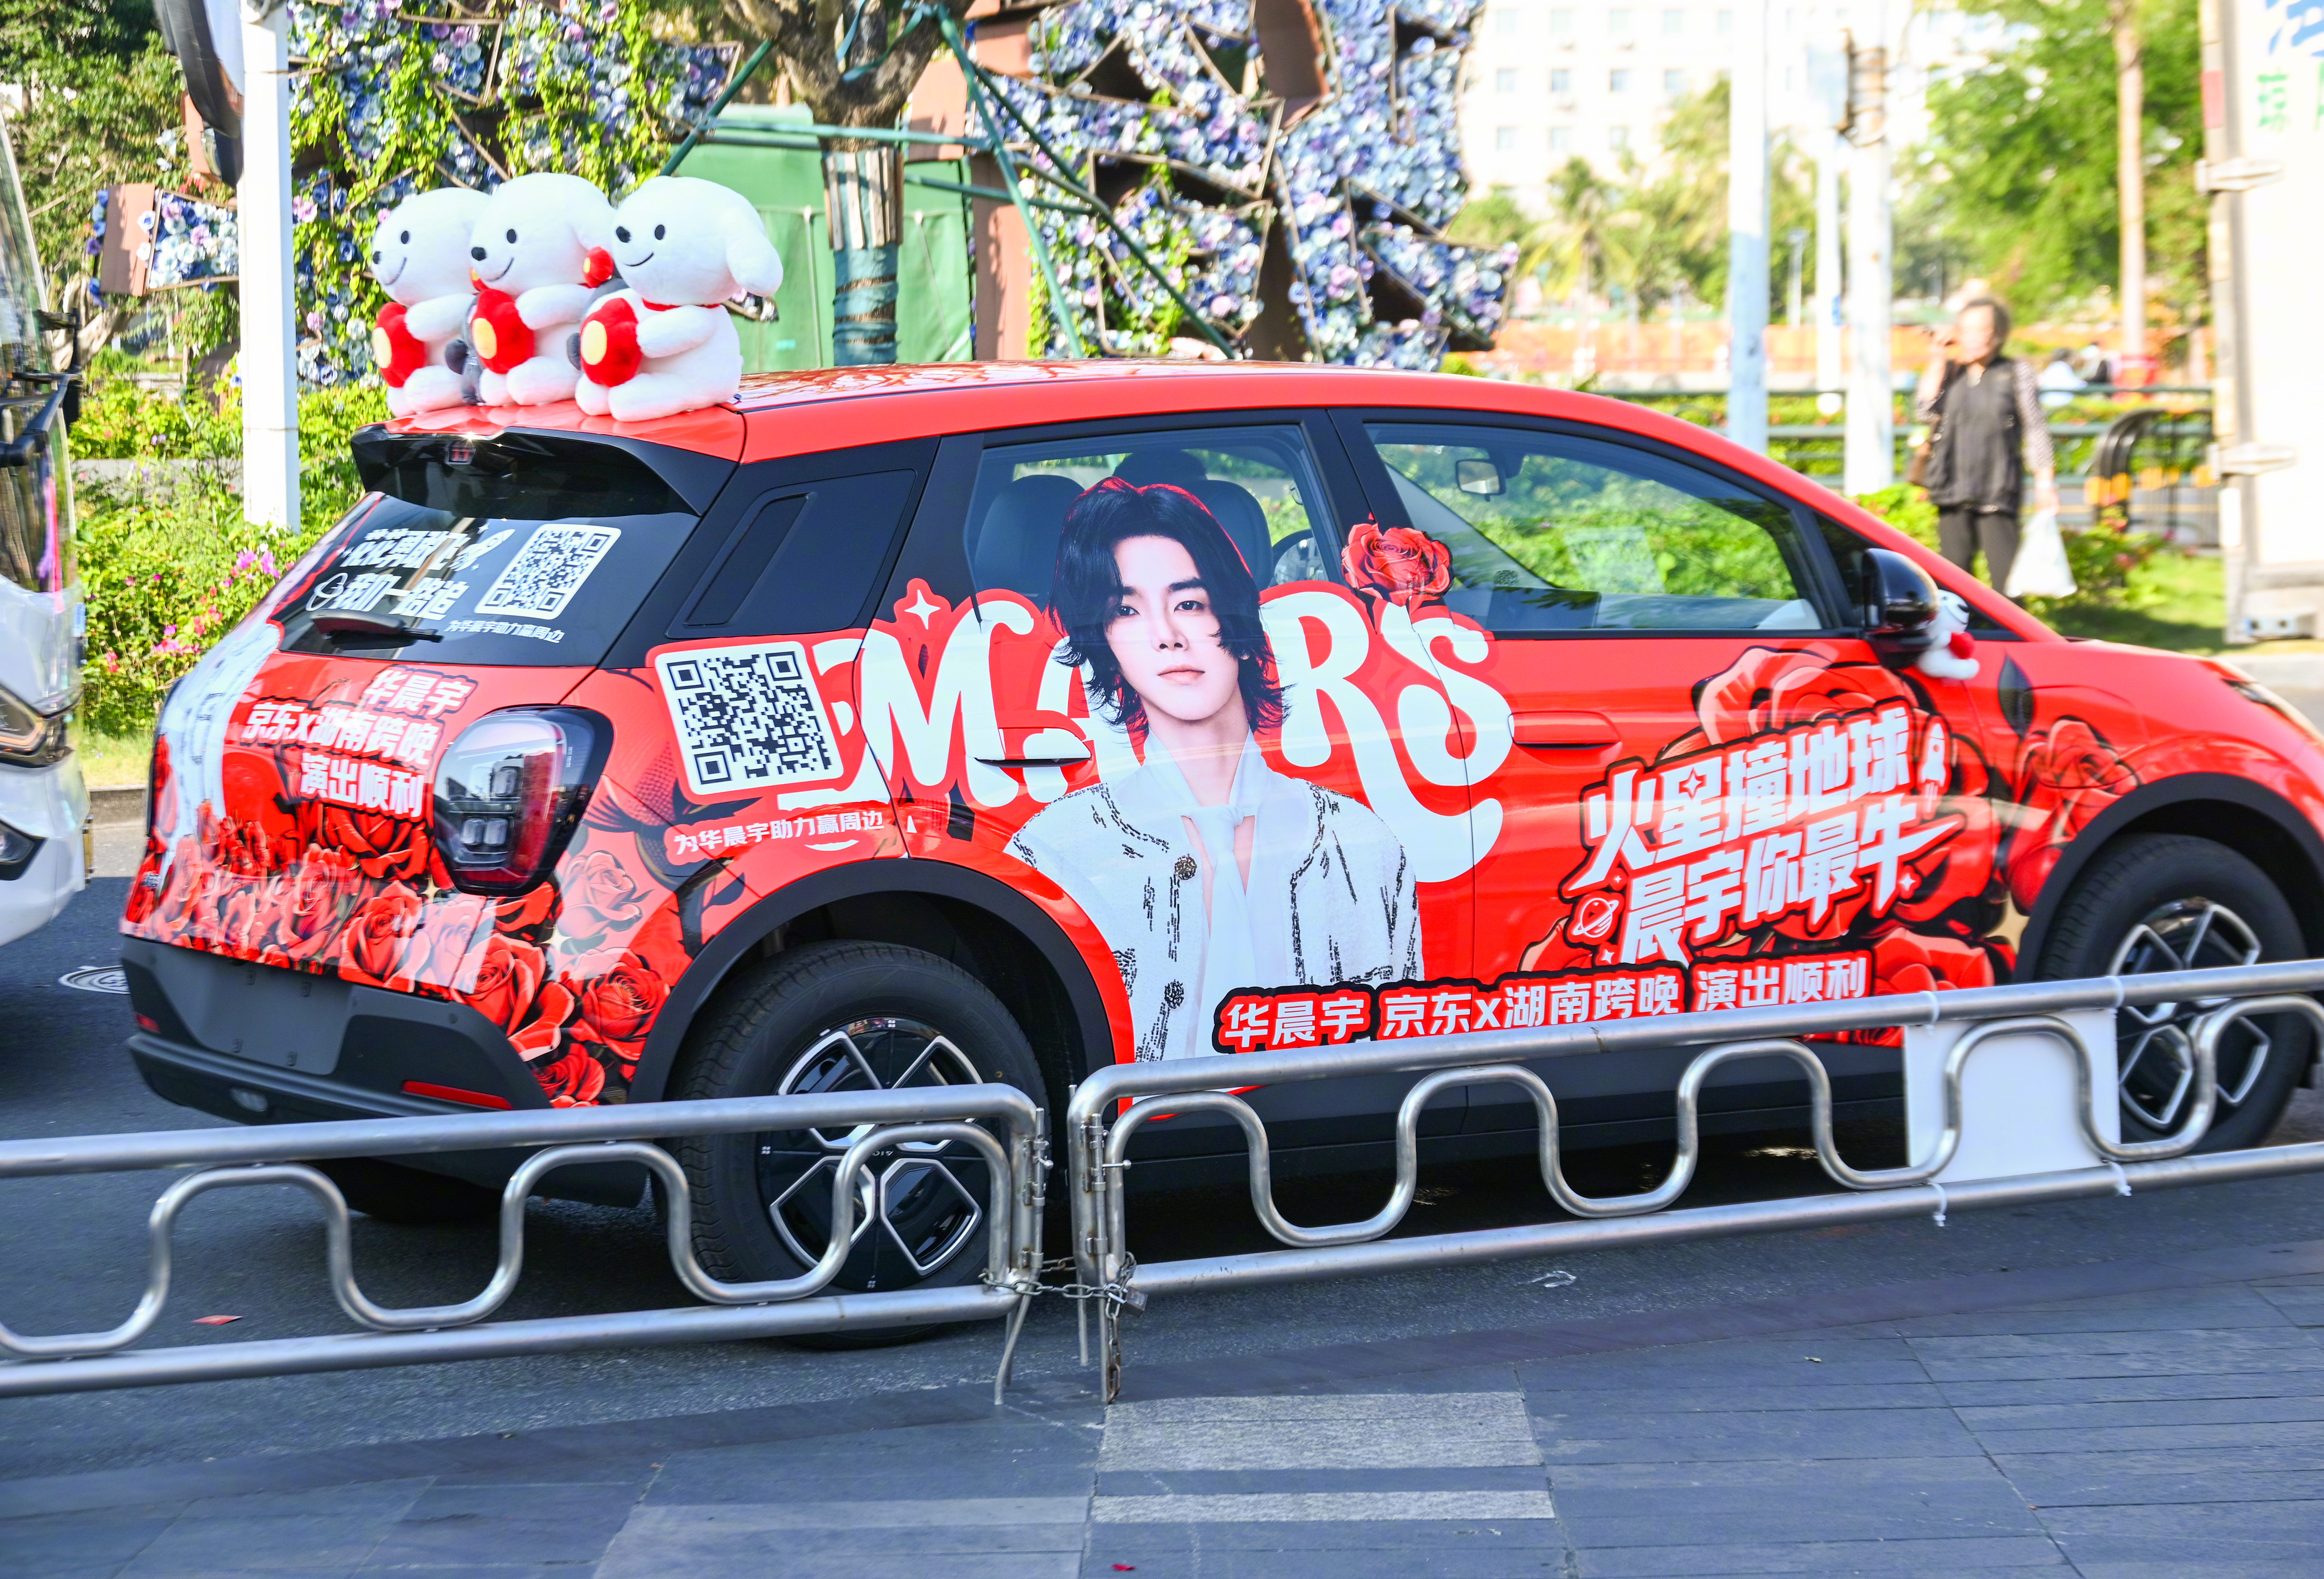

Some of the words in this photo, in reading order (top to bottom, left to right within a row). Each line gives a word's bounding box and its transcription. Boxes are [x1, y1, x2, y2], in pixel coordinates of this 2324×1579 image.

[339, 528, 471, 570] 花花勇敢飞
[328, 573, 470, 620] 我们一路追
[443, 620, 565, 643] 为华晨宇助力赢周边
[363, 669, 473, 716] 华晨宇
[300, 752, 425, 818] 演出顺利
[1563, 706, 1911, 891] 火星撞地球
[674, 810, 884, 855] 为华晨宇助力赢周边
[1619, 793, 1961, 967] 晨宇你最牛
[1225, 998, 1365, 1048] 华晨宇
[1697, 956, 1866, 1010] 演出顺利
